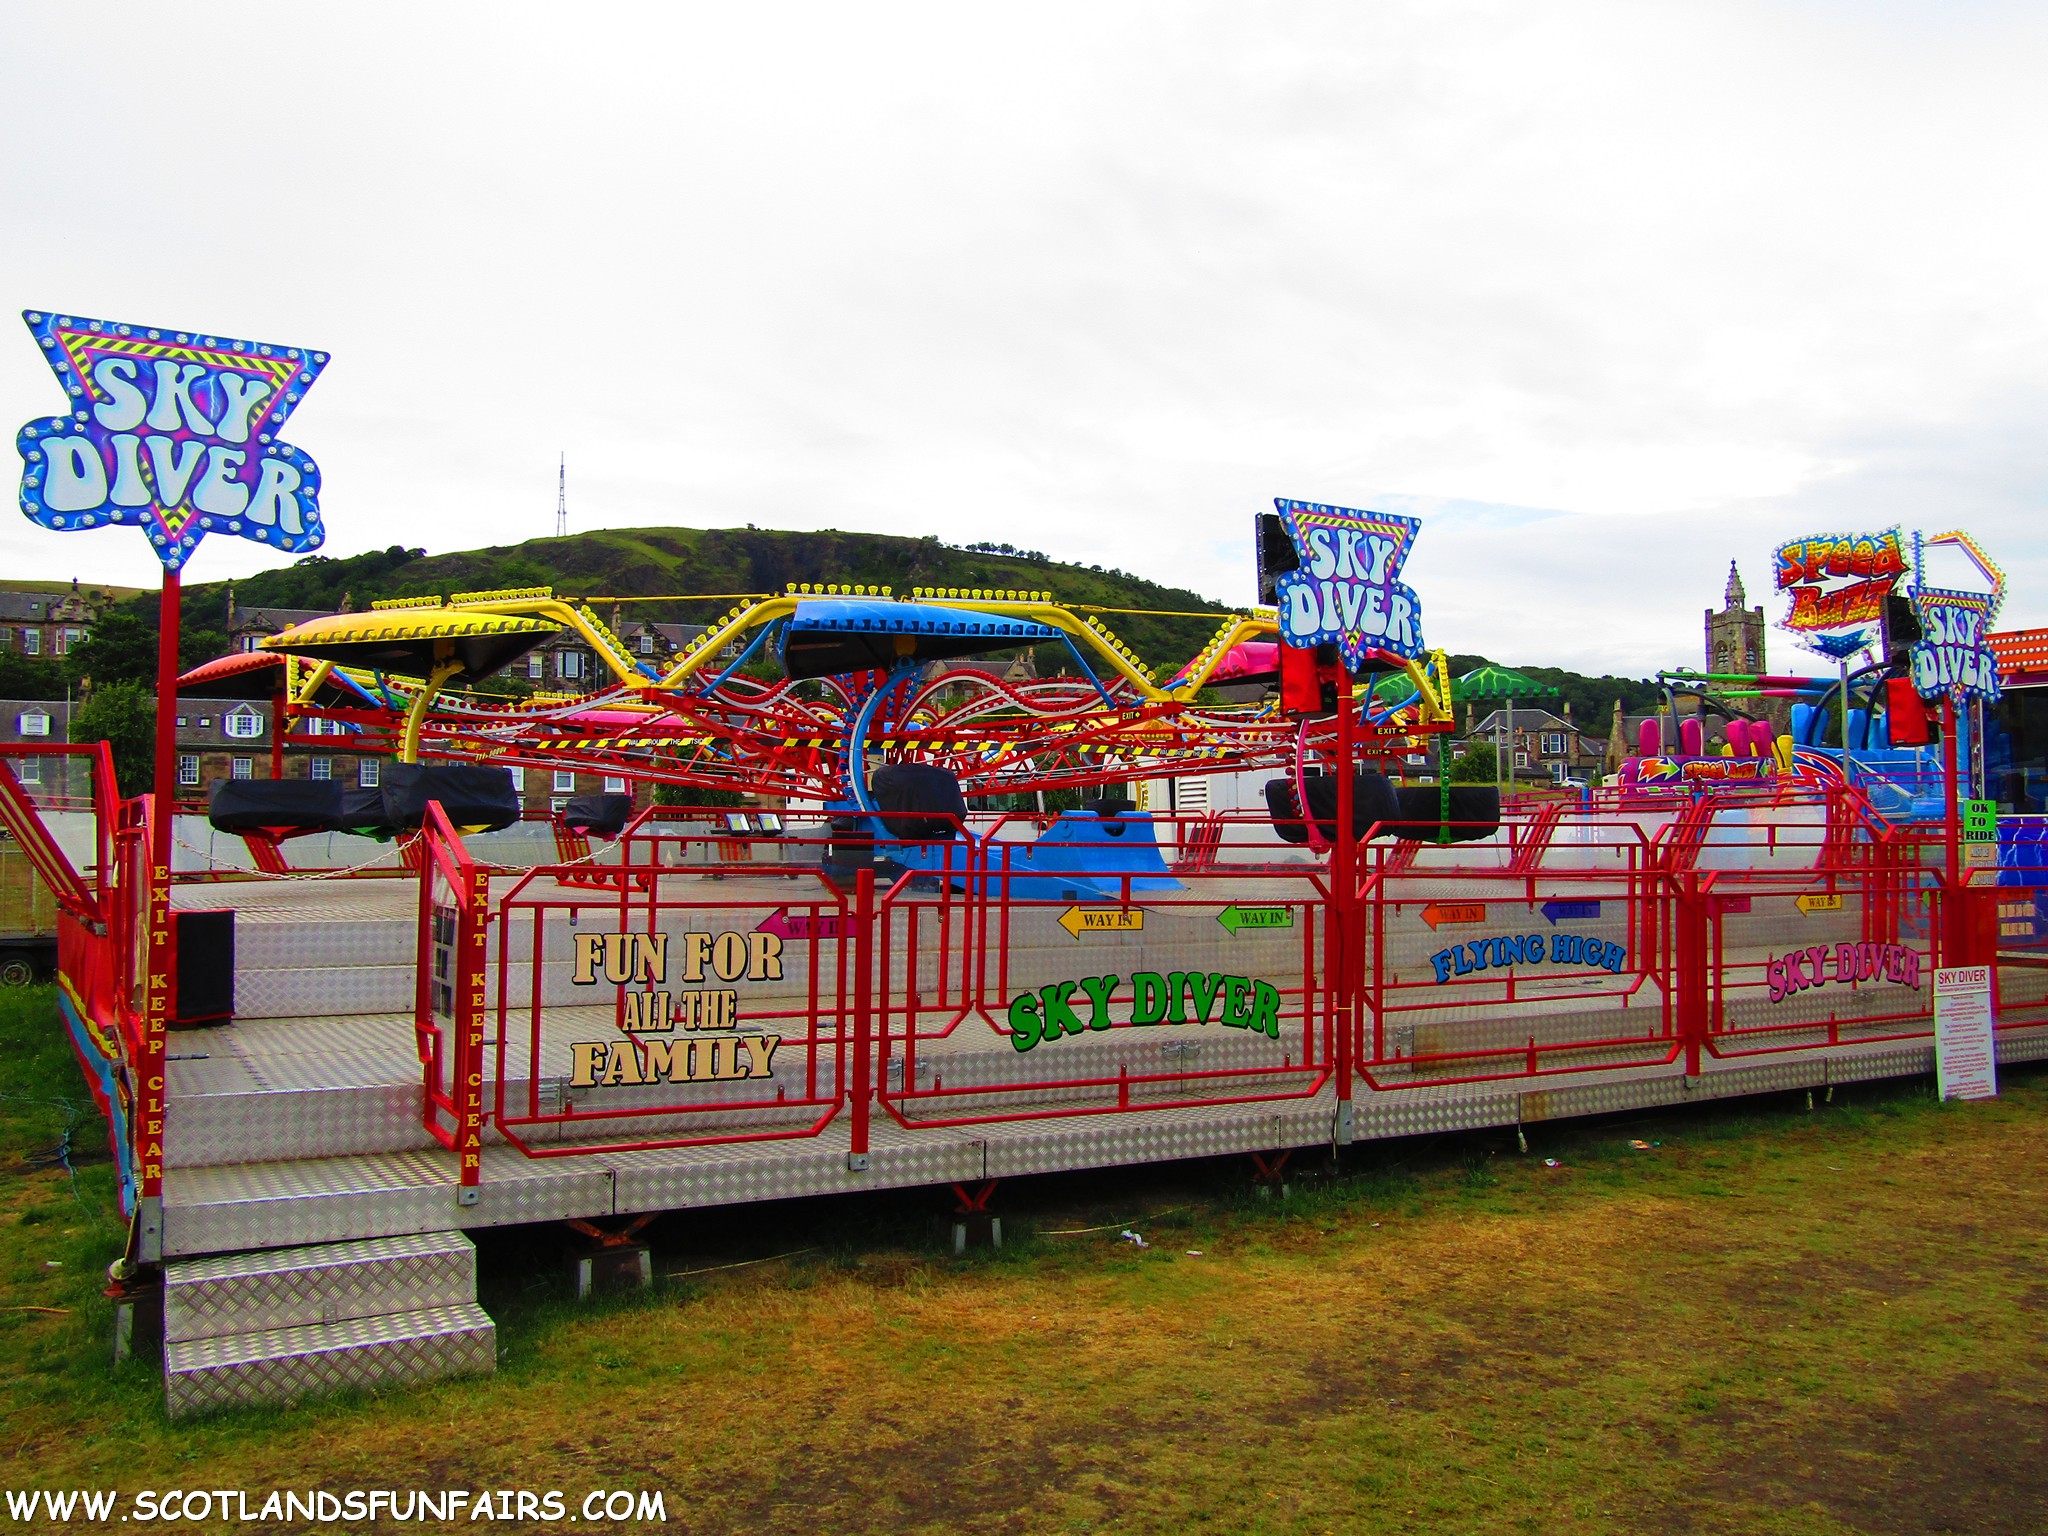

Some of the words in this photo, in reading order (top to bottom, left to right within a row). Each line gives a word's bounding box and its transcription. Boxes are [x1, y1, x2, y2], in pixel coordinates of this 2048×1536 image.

[93, 358, 271, 443] SKY
[40, 433, 304, 534] DIVER
[1309, 529, 1395, 585] SKY
[1287, 581, 1414, 647] DIVER
[1929, 606, 1980, 647] SKY
[1918, 645, 1994, 693] DIVER
[1122, 712, 1134, 720] EXIT
[1970, 816, 1986, 827] TO
[1971, 803, 1989, 814] OK
[1966, 830, 1995, 841] RIDE
[152, 865, 170, 946] EXIT
[473, 873, 488, 947] EXIT
[1083, 914, 1115, 927] WAY
[1117, 913, 1133, 926] IN
[1239, 912, 1268, 925] WAY
[1270, 911, 1284, 924] IN
[1439, 908, 1465, 920] WAY
[1466, 908, 1478, 919] IN
[1808, 897, 1825, 908] WAY
[572, 932, 668, 985] FUN
[682, 931, 784, 983] FOR
[1430, 934, 1545, 985] FLYING
[1550, 934, 1626, 974] HIGH
[1767, 945, 1829, 1003] SKY
[1835, 941, 1920, 991] DIVER
[1938, 971, 1957, 984] SKY
[1958, 969, 1986, 983] DIVER
[148, 974, 168, 1054] KEEP
[470, 973, 486, 1047] KEEP
[621, 991, 674, 1034] ALL
[681, 989, 738, 1031] THE
[1008, 974, 1120, 1053] SKY
[1130, 971, 1280, 1040] DIVER
[569, 1035, 781, 1088] FAMILY
[145, 1076, 164, 1178] CLEAR
[464, 1073, 482, 1168] CLEAR
